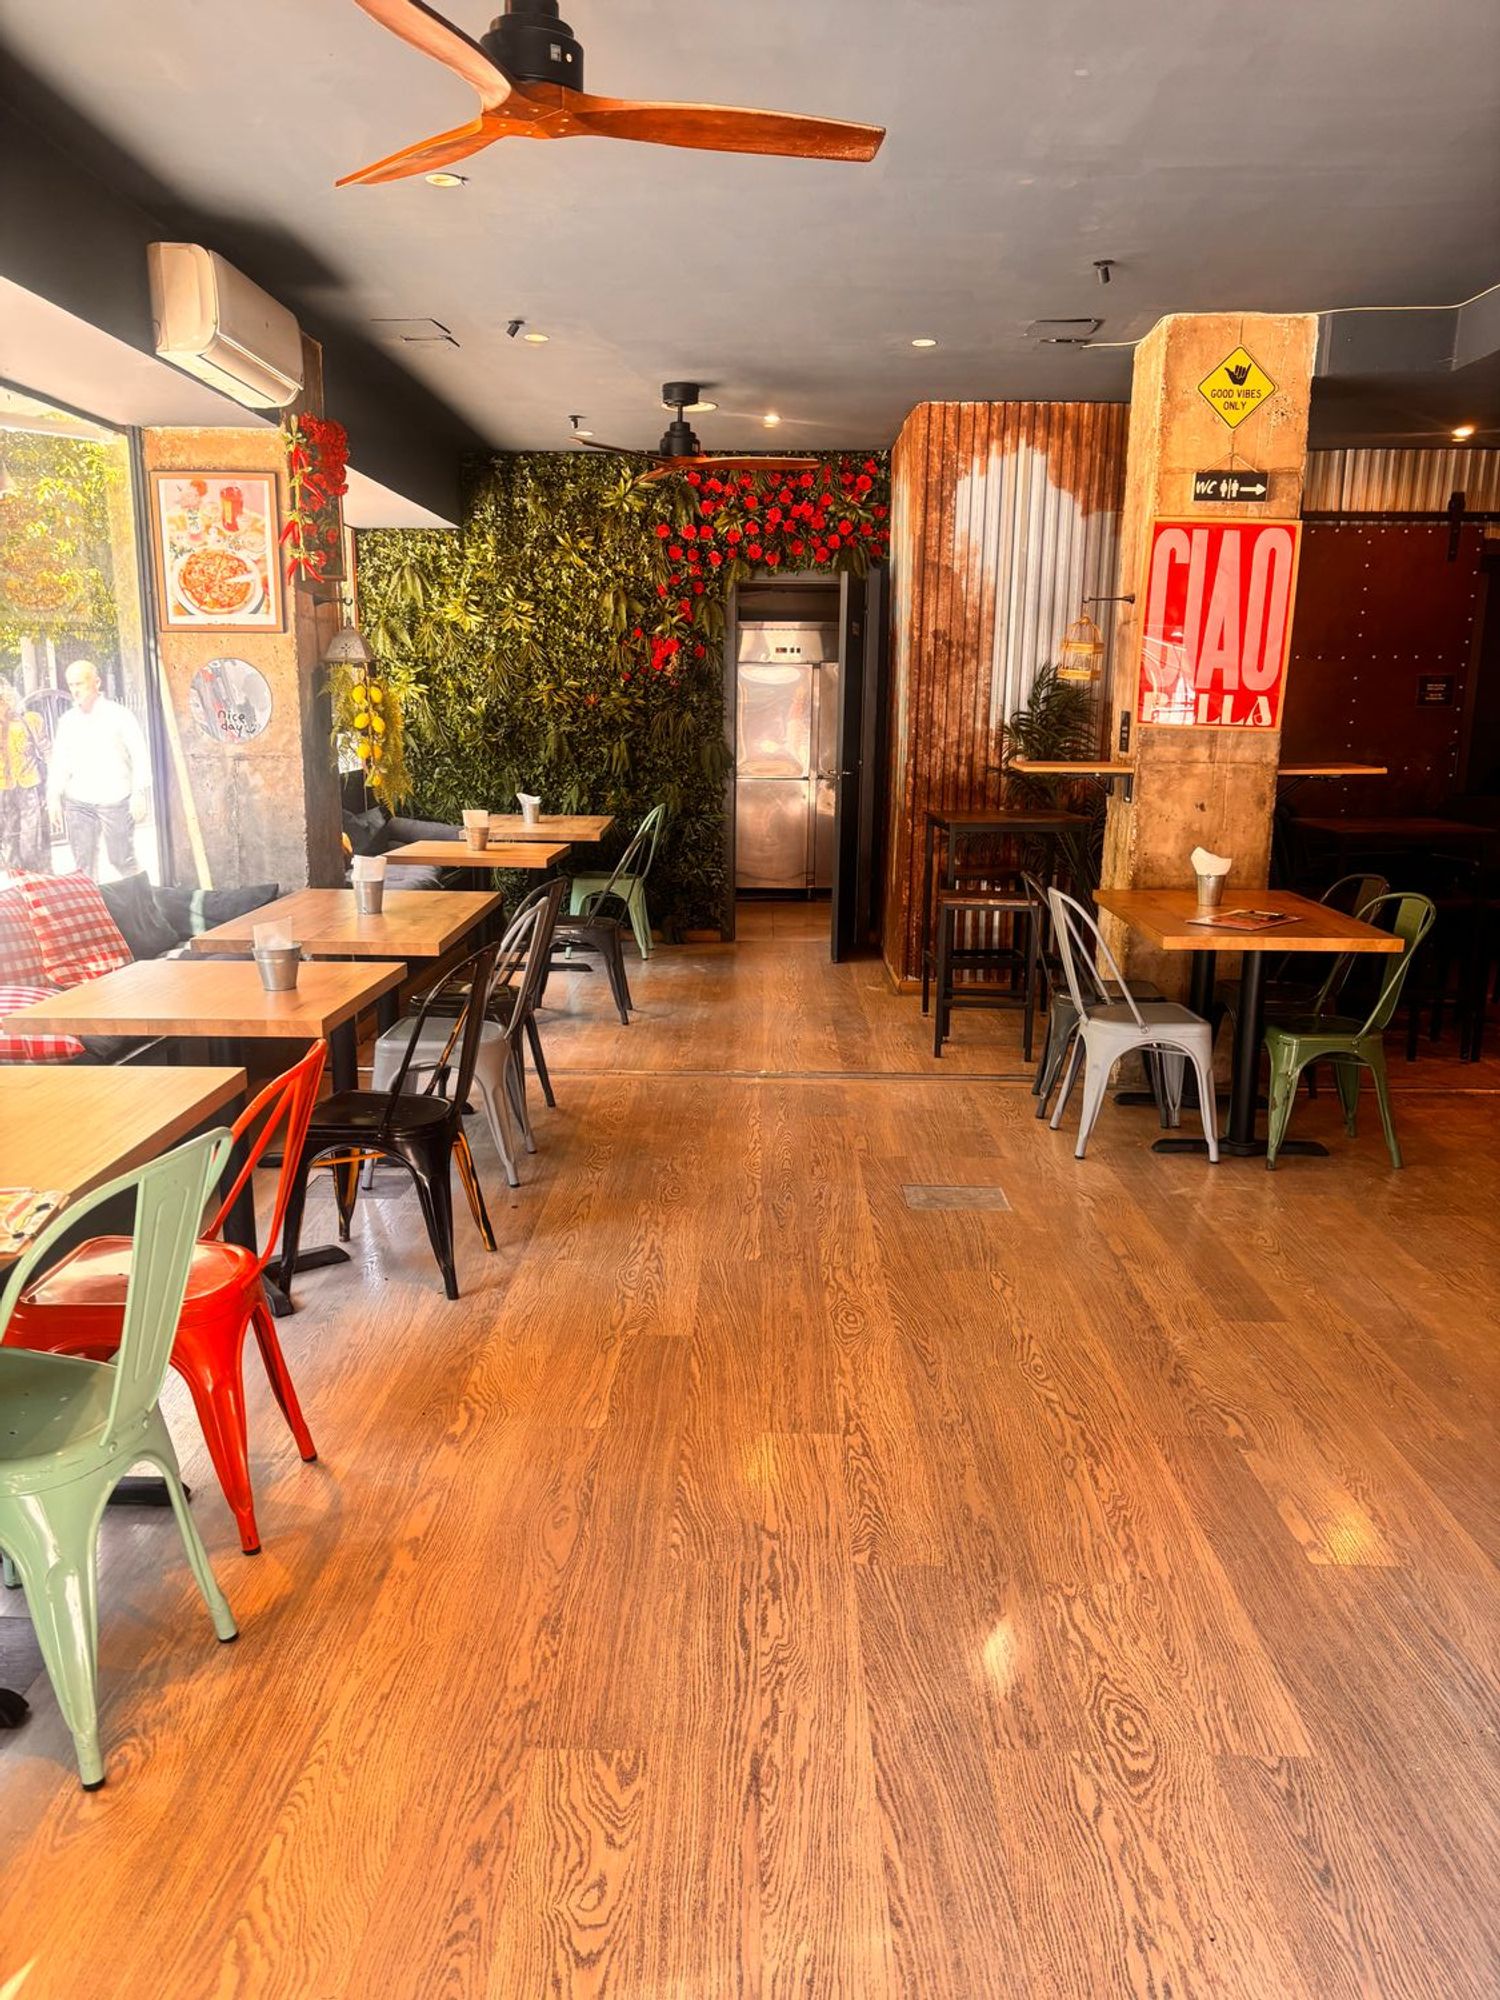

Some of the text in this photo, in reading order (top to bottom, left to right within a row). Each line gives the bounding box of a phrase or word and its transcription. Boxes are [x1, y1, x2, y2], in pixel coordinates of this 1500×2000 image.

[1210, 388, 1261, 398] GOOD VIBES
[1223, 401, 1246, 410] ONLY
[1195, 480, 1217, 494] WC
[1143, 528, 1292, 690] CIAO
[1141, 691, 1272, 726] BLLA
[217, 709, 246, 724] nice
[221, 720, 243, 738] day
